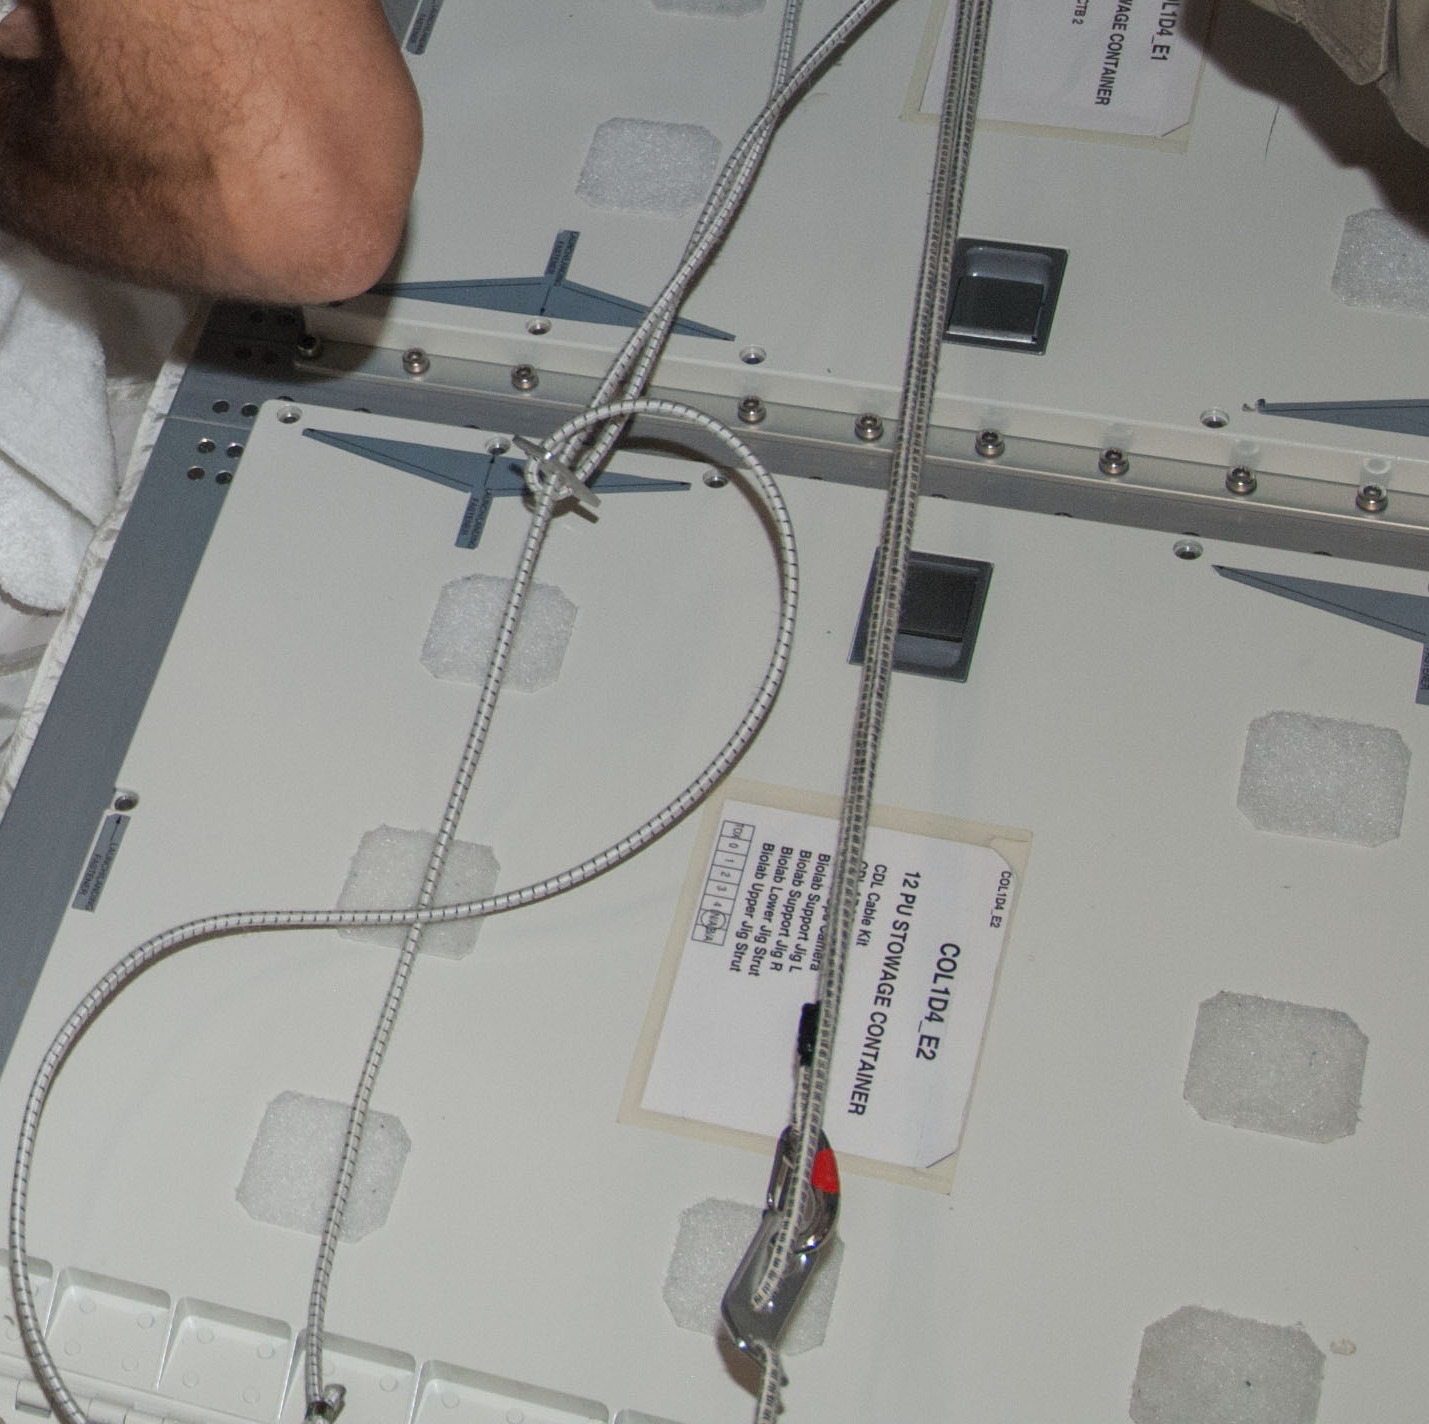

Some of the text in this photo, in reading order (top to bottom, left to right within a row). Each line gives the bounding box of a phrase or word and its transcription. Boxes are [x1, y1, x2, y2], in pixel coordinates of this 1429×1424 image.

[1071, 17, 1083, 26] 2
[1094, 31, 1125, 107] CONTAINER
[80, 853, 102, 896] FASTENER
[809, 853, 831, 890] Biolab
[869, 864, 887, 888] CDL
[729, 842, 775, 972] Biolab Upper Jig Strut
[748, 846, 793, 976] Biolab Lower Jig Strut
[769, 850, 812, 971] Biolab Support Jig R
[794, 893, 821, 940] Support
[860, 892, 881, 926] Cable
[988, 870, 1012, 928] COL1D4_E2
[788, 943, 808, 962] Jig
[855, 929, 871, 946] Kit
[788, 965, 802, 973] L
[847, 870, 921, 1117] 12 PU STOWAGE CONTAINER
[911, 941, 962, 1062] COL1D4_E2
